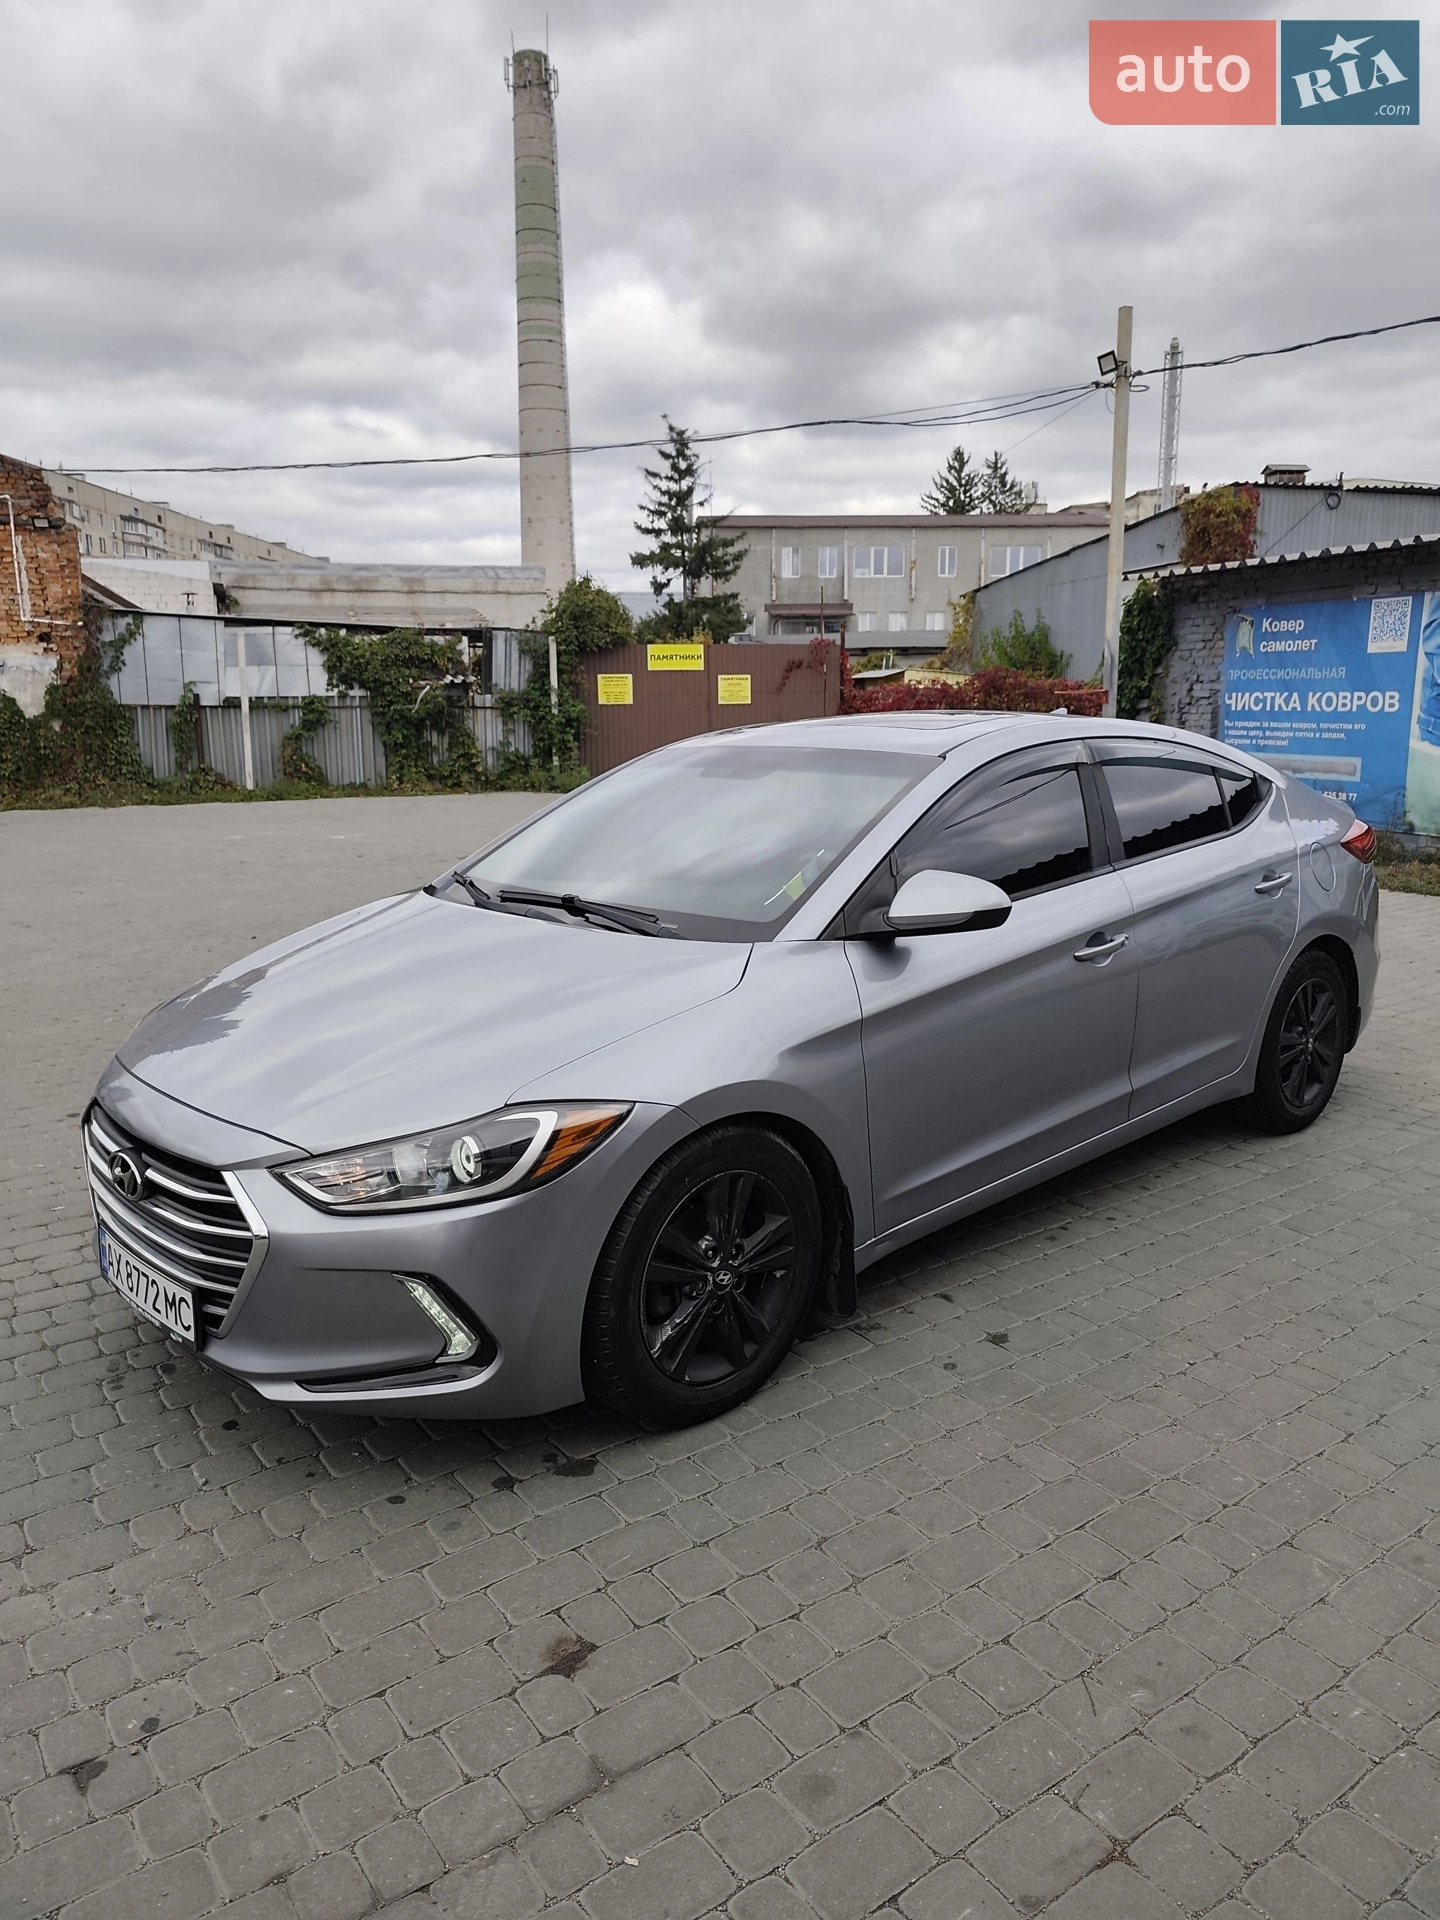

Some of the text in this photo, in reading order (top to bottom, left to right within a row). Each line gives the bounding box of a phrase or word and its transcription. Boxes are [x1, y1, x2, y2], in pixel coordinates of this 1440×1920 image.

[1261, 617, 1305, 634] Ковер
[1260, 639, 1318, 653] самолет
[650, 653, 702, 662] ПАМЯТНИКИ
[1227, 667, 1346, 680] ПРОФЕССИОНАЛЬНАЯ
[1225, 691, 1400, 712] ЧИСТКА КОВРОВ
[1348, 793, 1358, 801] 77
[125, 1260, 162, 1315] 8772
[163, 1284, 192, 1332] MC
